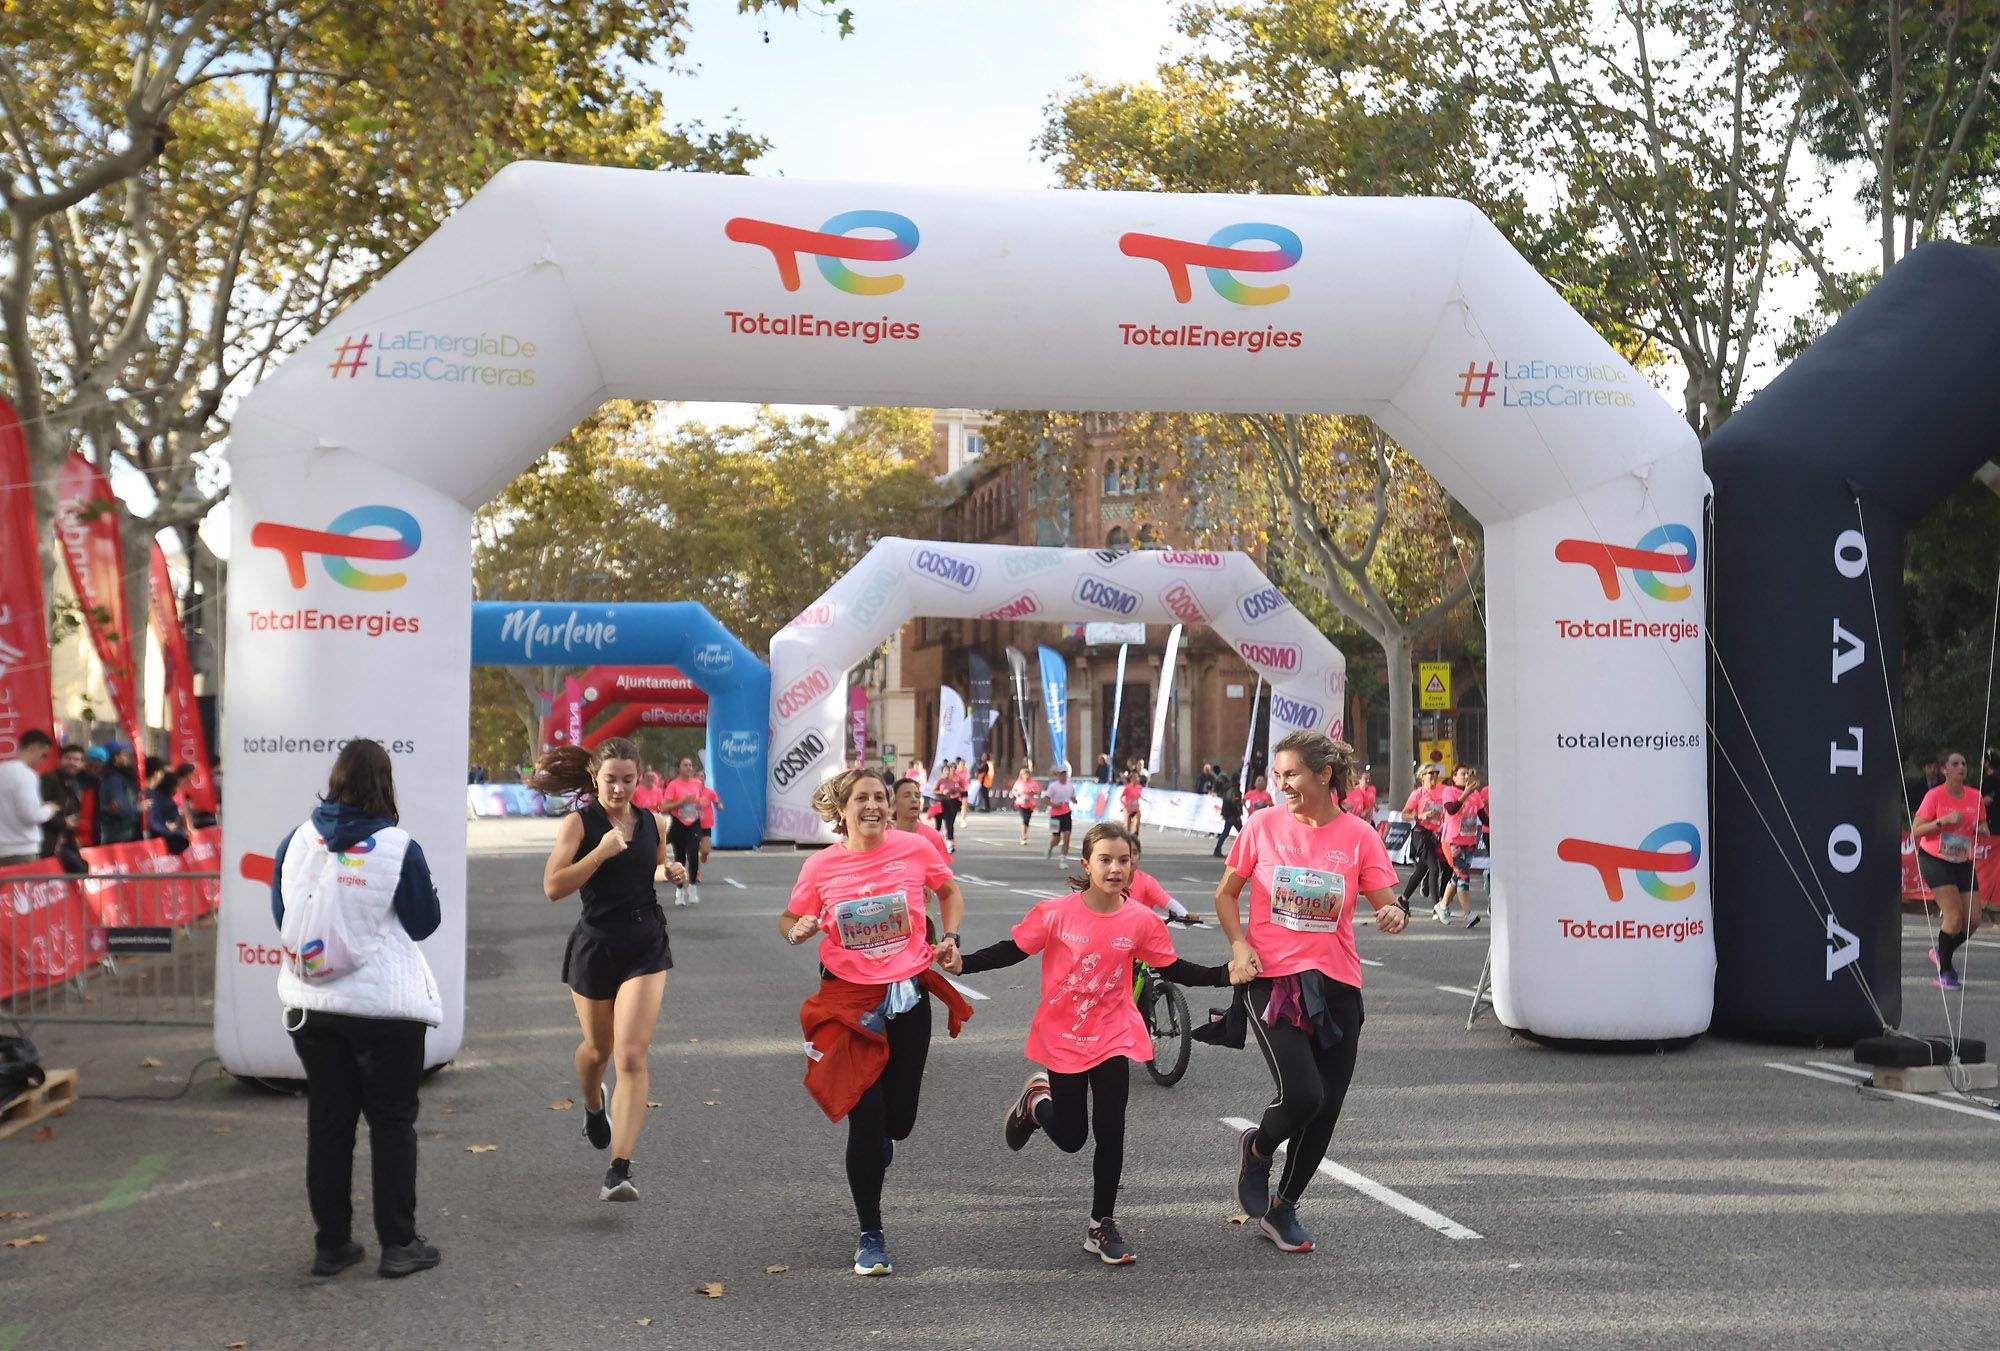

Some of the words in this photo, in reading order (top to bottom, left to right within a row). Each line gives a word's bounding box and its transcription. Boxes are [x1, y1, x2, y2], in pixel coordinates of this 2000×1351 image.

[724, 311, 920, 344] TotalEnergies
[1118, 323, 1303, 353] TotalEnergies
[375, 356, 535, 387] LasCarreras
[1503, 384, 1635, 408] LasCarreras
[916, 550, 974, 587] COSMO
[1080, 579, 1137, 615] COSMO
[248, 609, 420, 637] TotalEnergies
[501, 608, 617, 659] Marlene
[1555, 617, 1699, 643] TotalEnergies
[1239, 642, 1297, 670] COSMO
[616, 674, 694, 690] Ajuntament
[776, 668, 830, 720] COSMO
[641, 709, 707, 724] elPeriódi
[1556, 731, 1700, 751] totalenergies.es
[1825, 529, 1868, 981] VOLVO
[773, 733, 825, 787] COSMO
[1557, 916, 1704, 942] TotalEnergies
